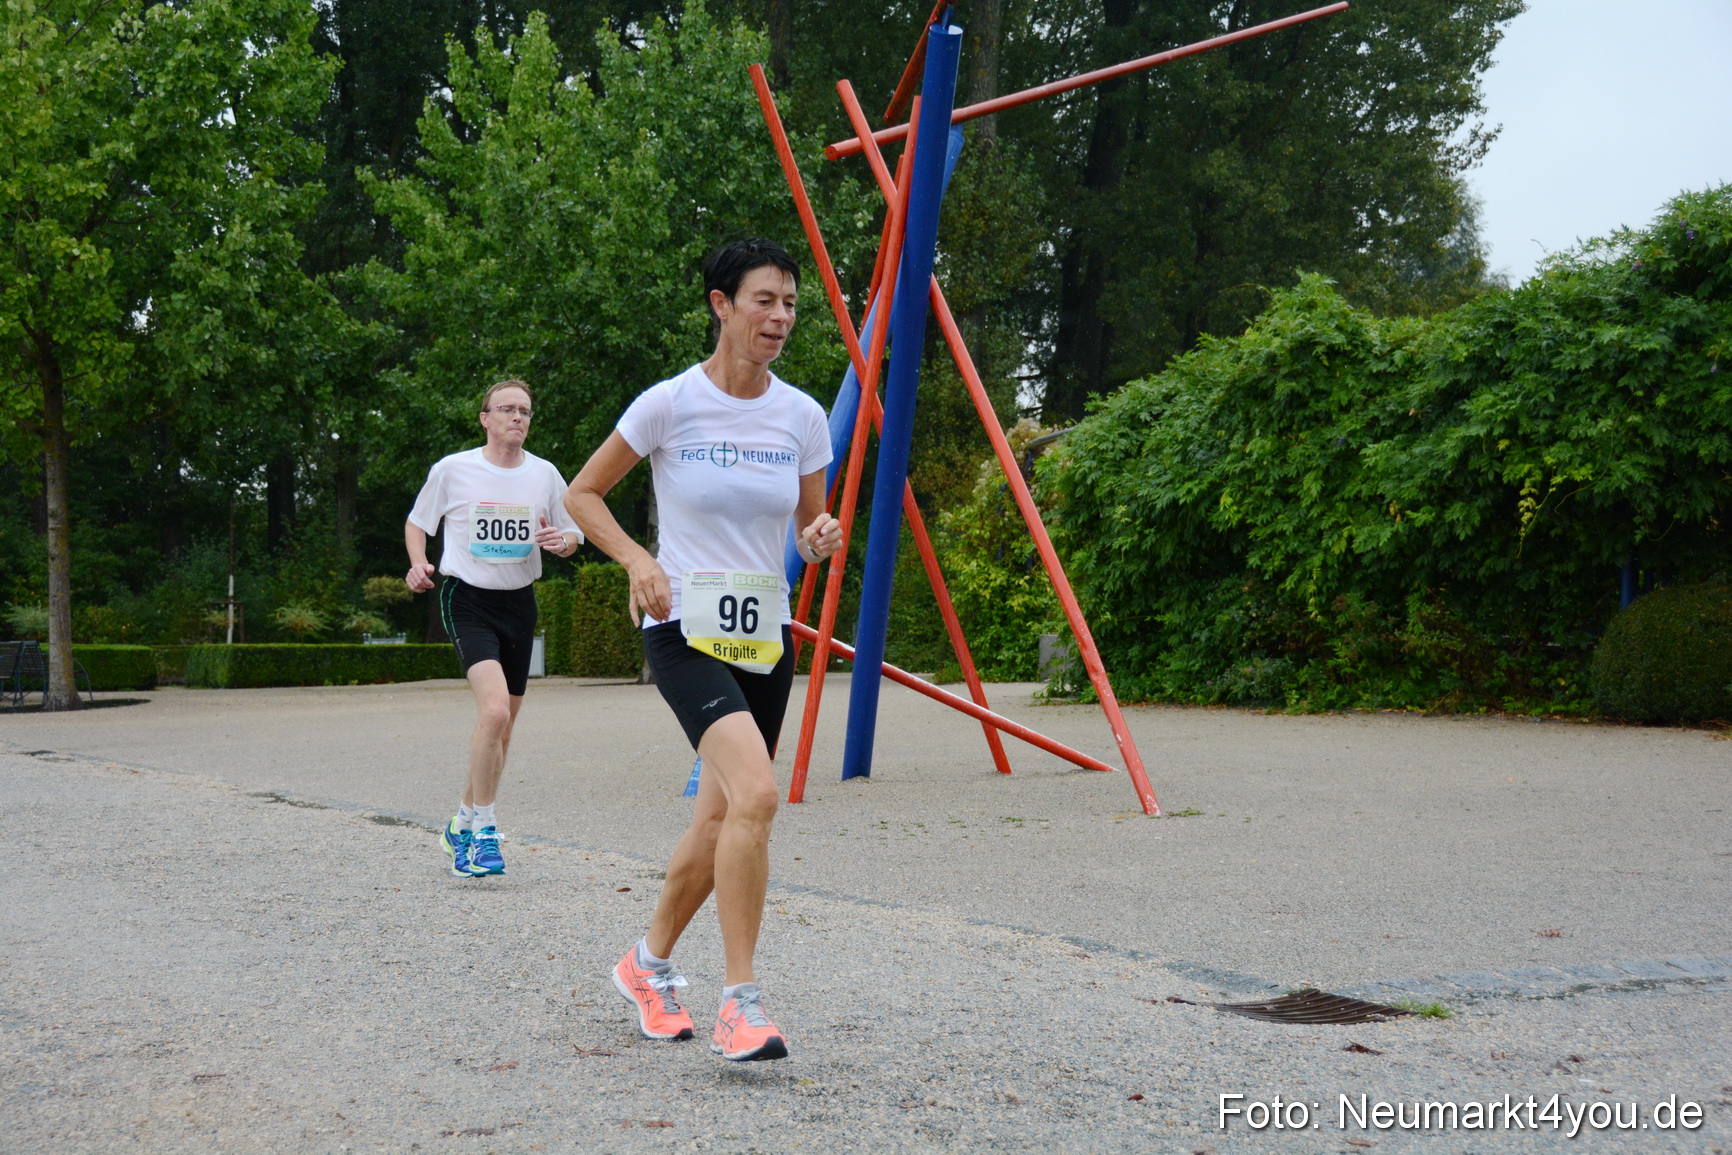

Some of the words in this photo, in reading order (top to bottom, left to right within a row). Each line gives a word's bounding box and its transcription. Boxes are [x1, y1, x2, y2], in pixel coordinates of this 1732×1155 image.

[681, 449, 706, 461] FeG
[742, 450, 796, 466] NEUMARKT
[476, 518, 530, 541] 3065
[483, 545, 512, 554] Stefan
[733, 573, 778, 588] BOCK
[719, 594, 759, 635] 96
[713, 643, 757, 661] Brigitte
